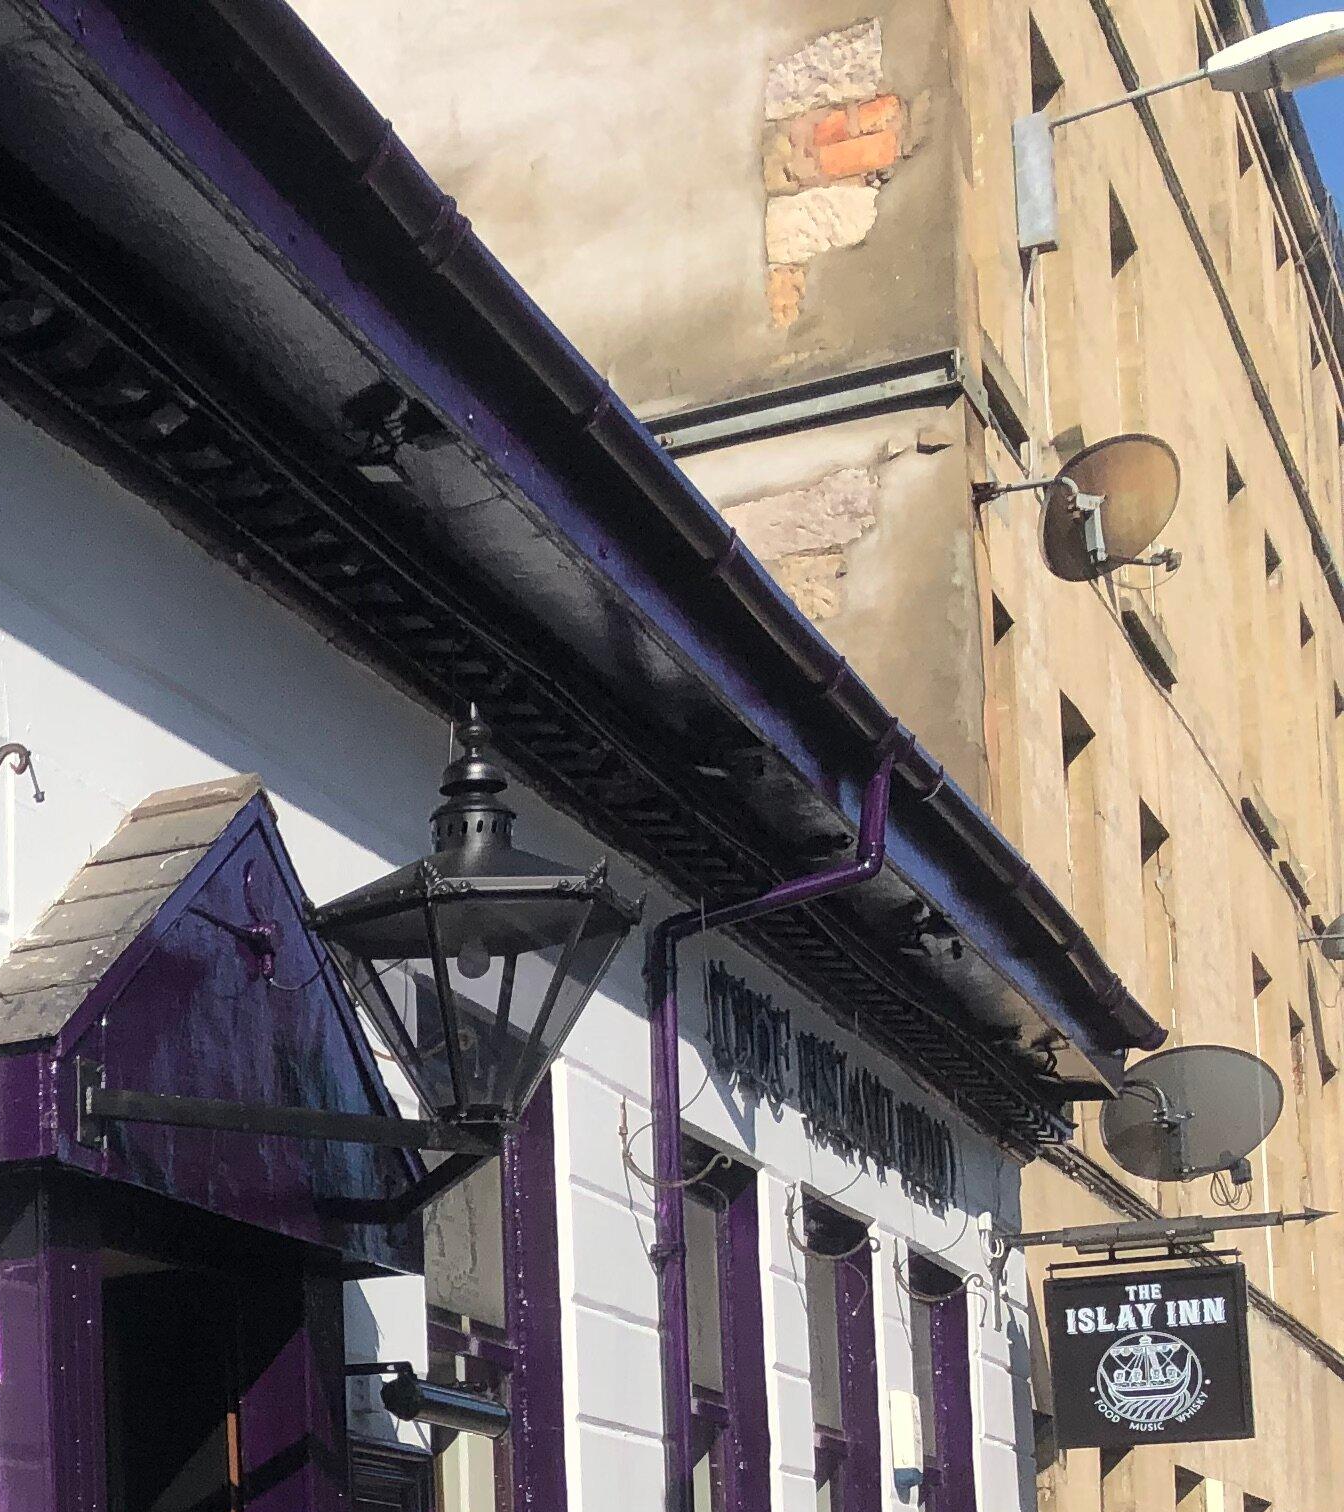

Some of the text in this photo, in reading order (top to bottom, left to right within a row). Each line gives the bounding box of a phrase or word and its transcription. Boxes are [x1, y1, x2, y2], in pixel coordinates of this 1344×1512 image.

[1125, 1284, 1162, 1301] THE
[1065, 1297, 1227, 1334] ISLAY INN
[1094, 1392, 1208, 1431] FOOD MUSIC WHISKY
